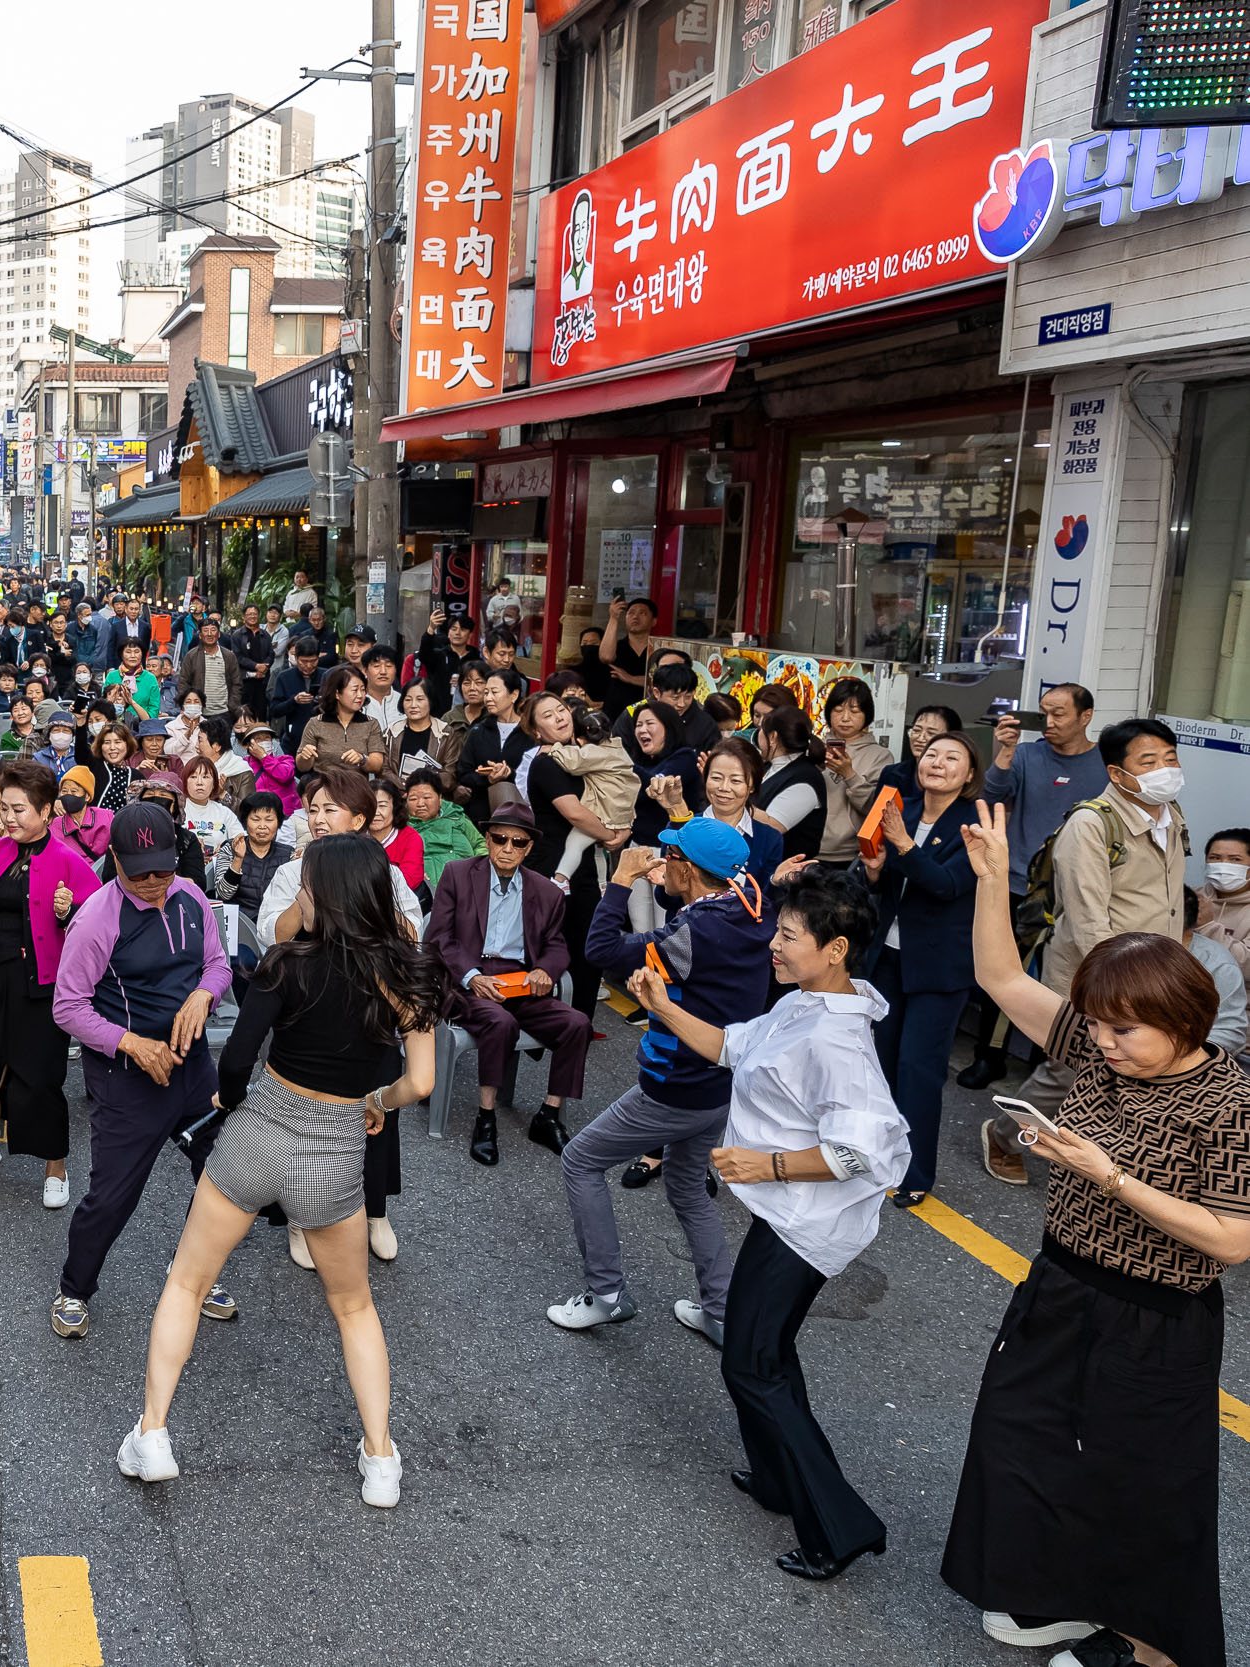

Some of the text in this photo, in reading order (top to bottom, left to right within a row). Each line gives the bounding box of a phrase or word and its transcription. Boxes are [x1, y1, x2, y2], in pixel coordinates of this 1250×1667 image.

[613, 26, 994, 263] 牛肉面大王
[415, 5, 459, 412] 국가주우육면대
[802, 234, 970, 302] 가맹/예약문의 02 6465 8999
[611, 250, 709, 327] 우육면대왕
[1045, 309, 1105, 340] 건대직영점
[1069, 399, 1105, 417] 피부과
[1072, 418, 1097, 437] 전용
[1064, 438, 1101, 455] 기능성
[1061, 457, 1098, 475] 화장품
[620, 533, 632, 542] 10
[1041, 577, 1083, 655] Dr.
[1175, 721, 1217, 736] Bioderm
[136, 826, 155, 849] NY
